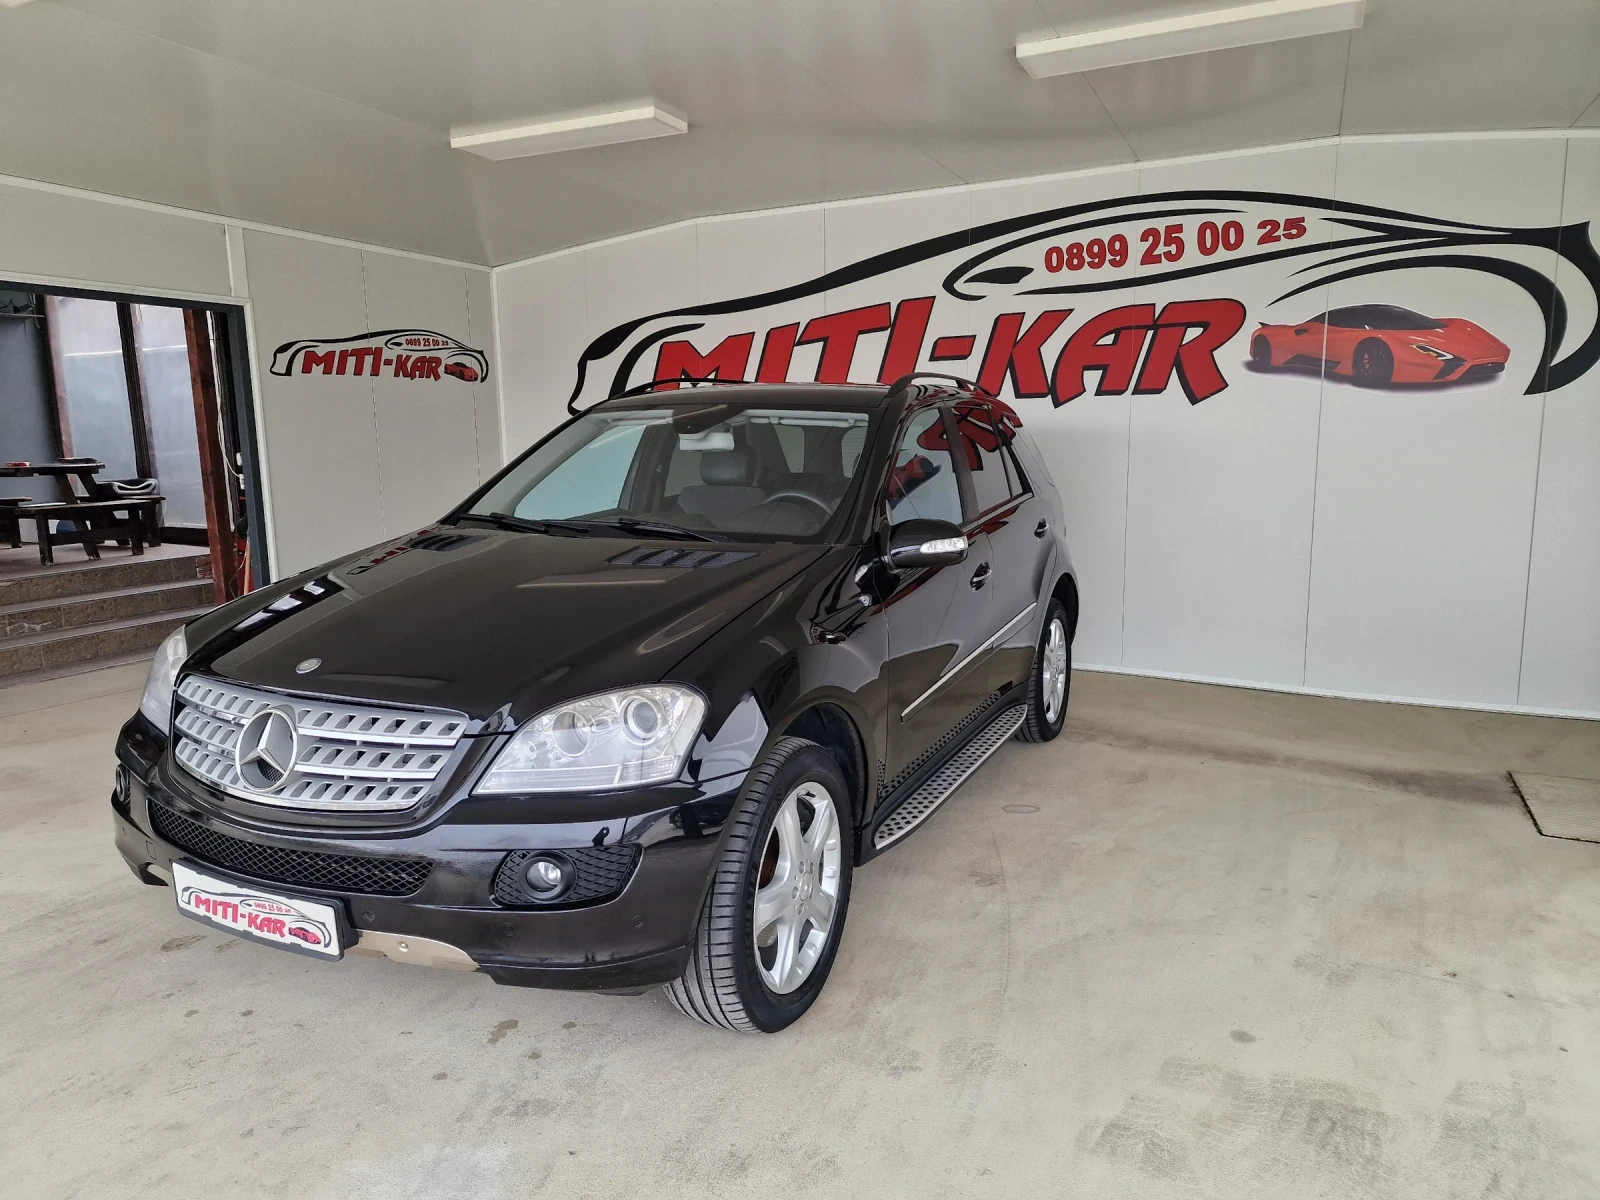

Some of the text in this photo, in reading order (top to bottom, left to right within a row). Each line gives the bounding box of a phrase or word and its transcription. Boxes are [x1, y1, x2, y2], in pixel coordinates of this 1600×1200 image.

[1044, 216, 1307, 273] 0899 25 00 25
[301, 347, 443, 382] MITI-KAR
[405, 337, 422, 347] 0899
[422, 337, 431, 347] 25
[432, 338, 440, 347] 00
[652, 295, 1247, 408] MITI-KAR
[194, 893, 286, 938] MITI-KAR
